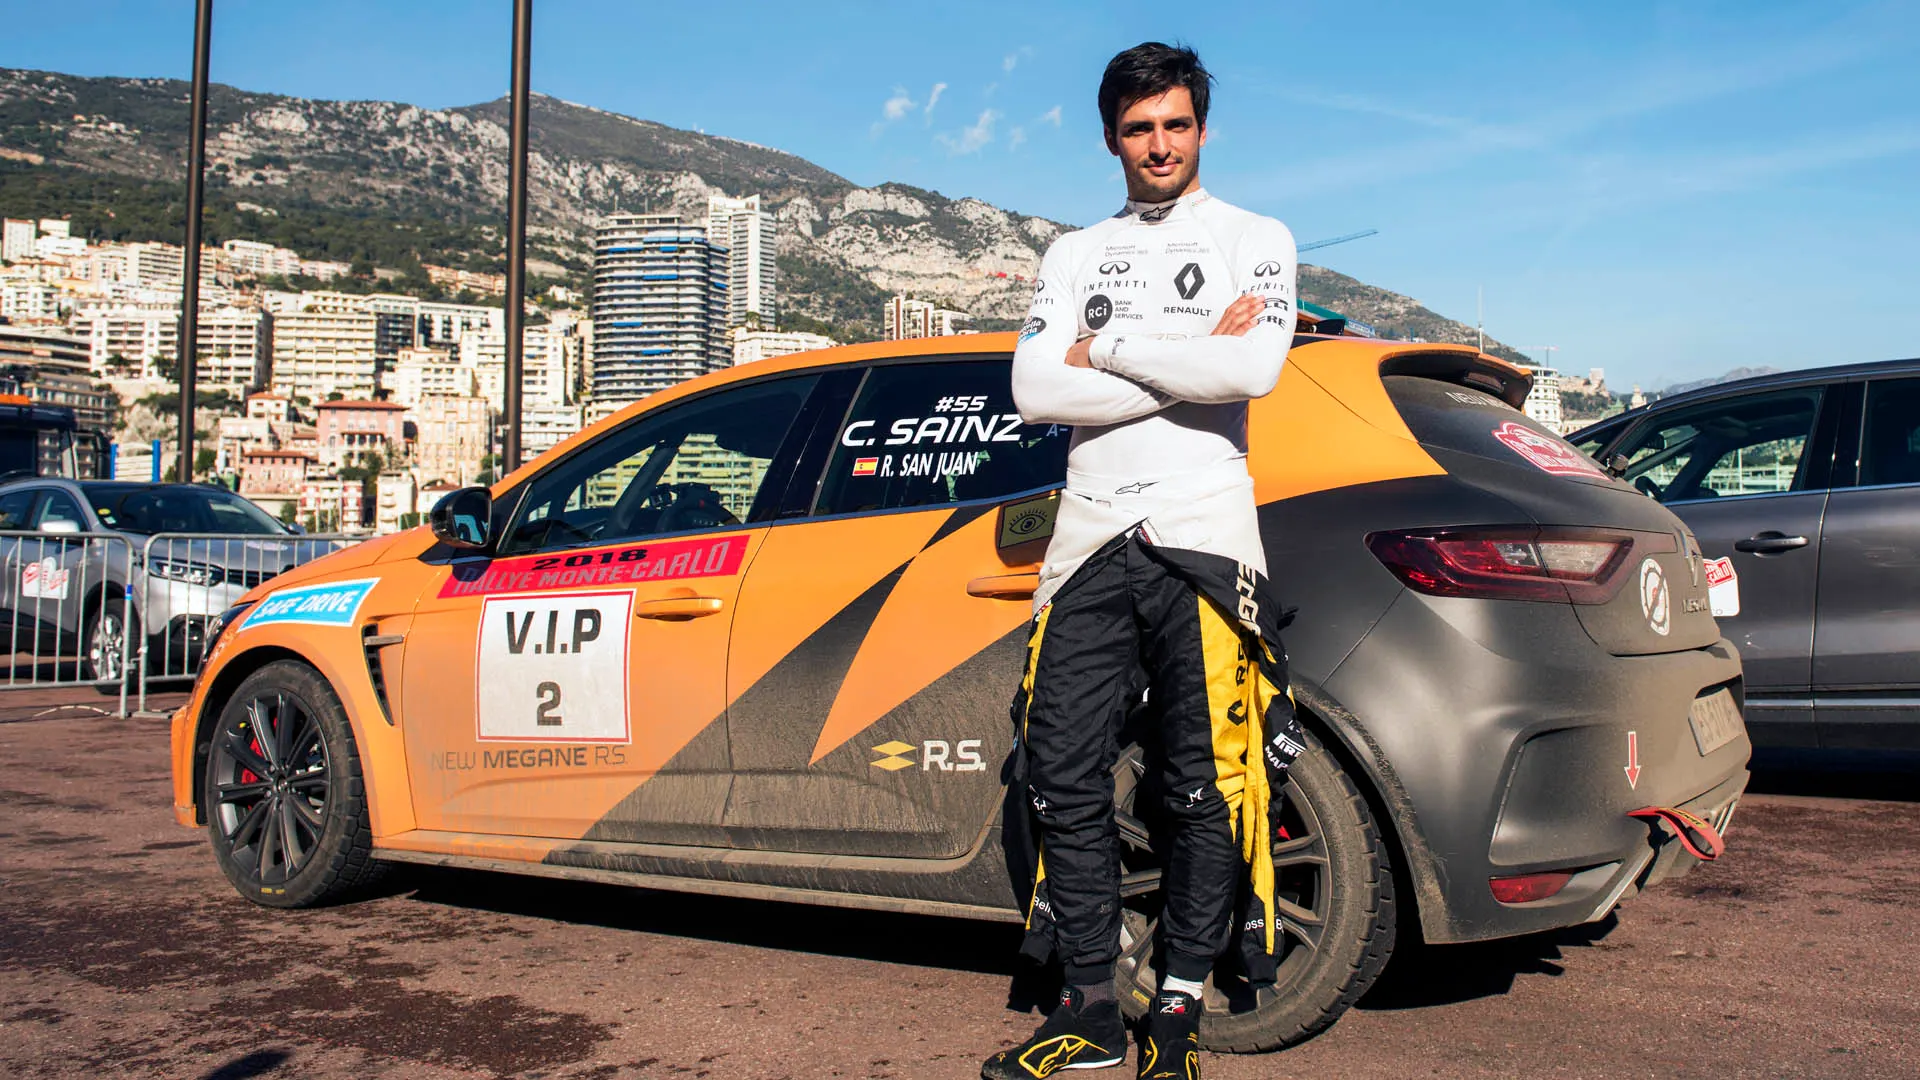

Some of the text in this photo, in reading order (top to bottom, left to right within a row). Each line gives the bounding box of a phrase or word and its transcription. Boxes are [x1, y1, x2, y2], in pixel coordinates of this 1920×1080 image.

[1083, 280, 1147, 294] INFINITI
[1163, 306, 1212, 318] RENAULT
[935, 395, 988, 412] #55
[841, 413, 1024, 446] C. SAINZ
[880, 452, 979, 483] R. SAN JUAN
[451, 541, 731, 595] RALLYE MONTE-CARLO
[530, 549, 648, 571] 2018
[253, 590, 360, 620] SAFE DRIVE
[506, 608, 602, 655] V.I.P
[536, 681, 563, 727] 2
[432, 751, 476, 771] NEW
[483, 747, 587, 769] MEGANE
[923, 739, 987, 771] R.S.
